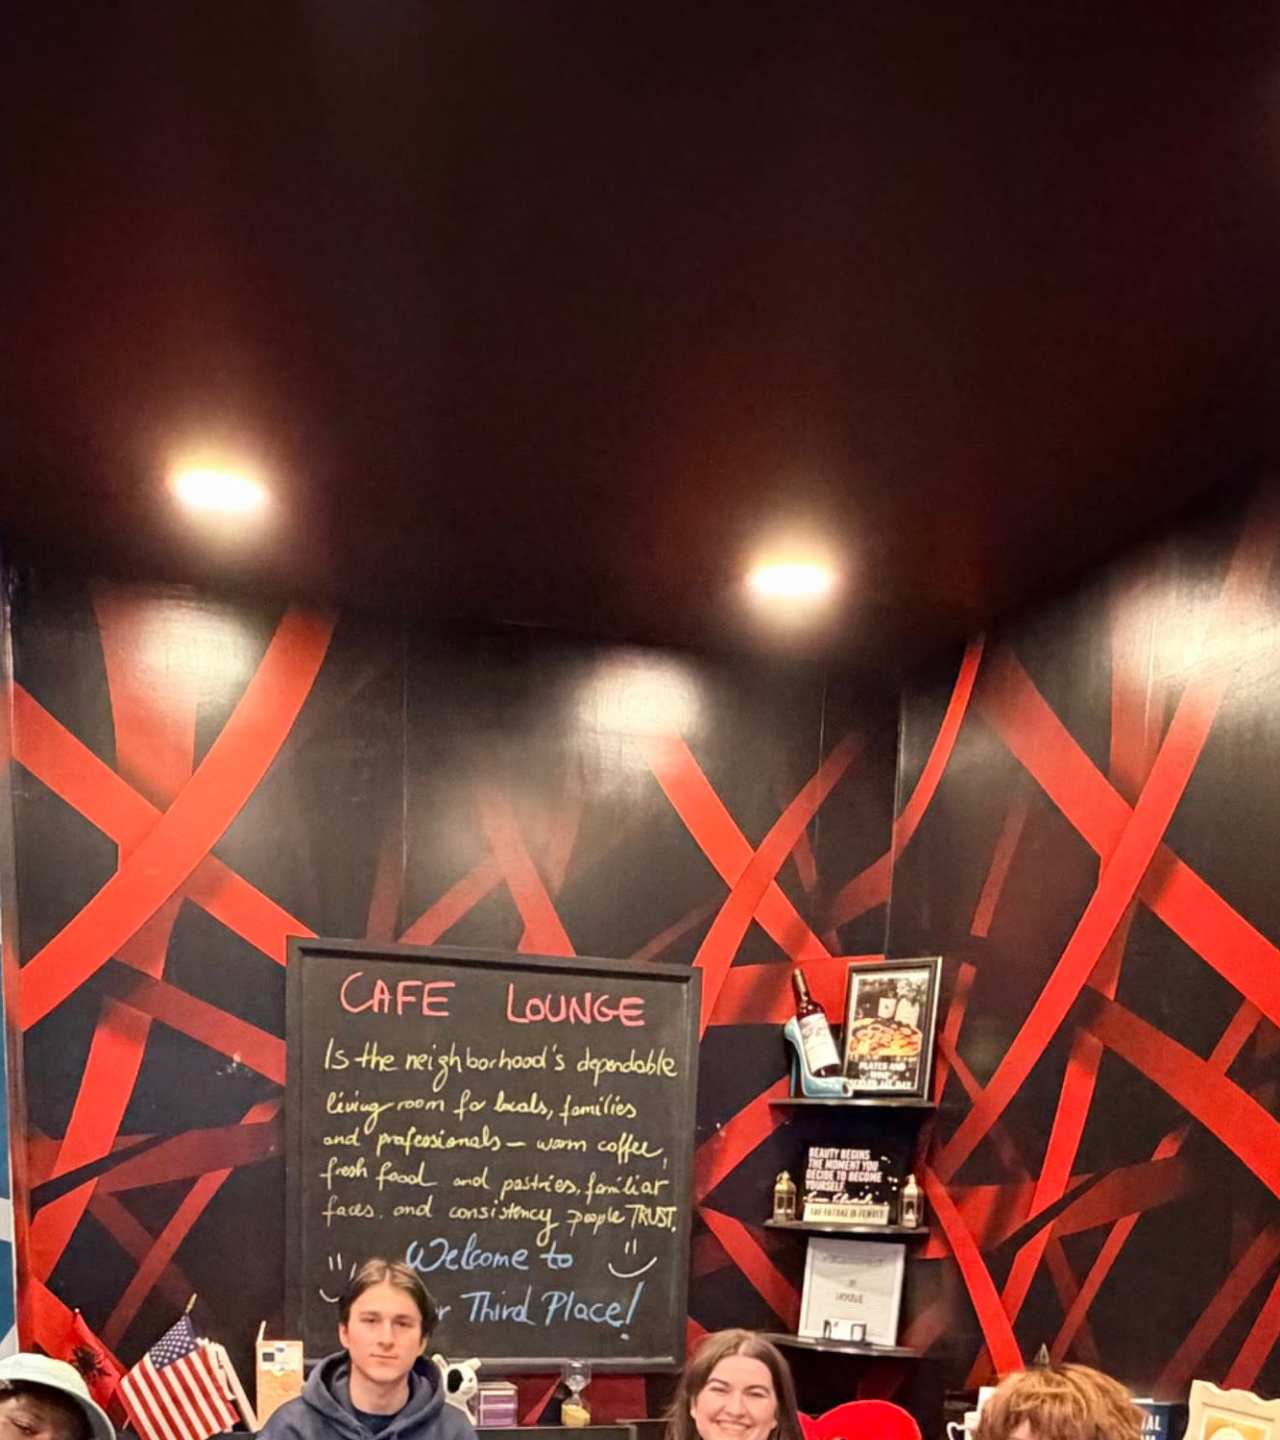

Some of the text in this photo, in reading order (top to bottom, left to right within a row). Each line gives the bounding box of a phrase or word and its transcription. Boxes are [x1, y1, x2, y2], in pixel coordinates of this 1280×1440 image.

[340, 972, 646, 1027] CAFE LOUNGE
[324, 1038, 679, 1093] Is the neighborhood's dependable
[325, 1090, 393, 1135] living
[396, 1097, 446, 1113] room
[558, 1094, 638, 1126] families
[323, 1127, 360, 1147] and
[376, 1125, 501, 1157] professionals
[536, 1137, 588, 1153] warm
[319, 1156, 368, 1191] fresh
[375, 1161, 439, 1191] food
[453, 1165, 491, 1190] and
[583, 1171, 671, 1205] familiar
[392, 1194, 433, 1219] and
[449, 1200, 560, 1247] consistency
[566, 1205, 626, 1236] people
[405, 1232, 574, 1272] Welcome to
[460, 1281, 646, 1341] Third Place!
